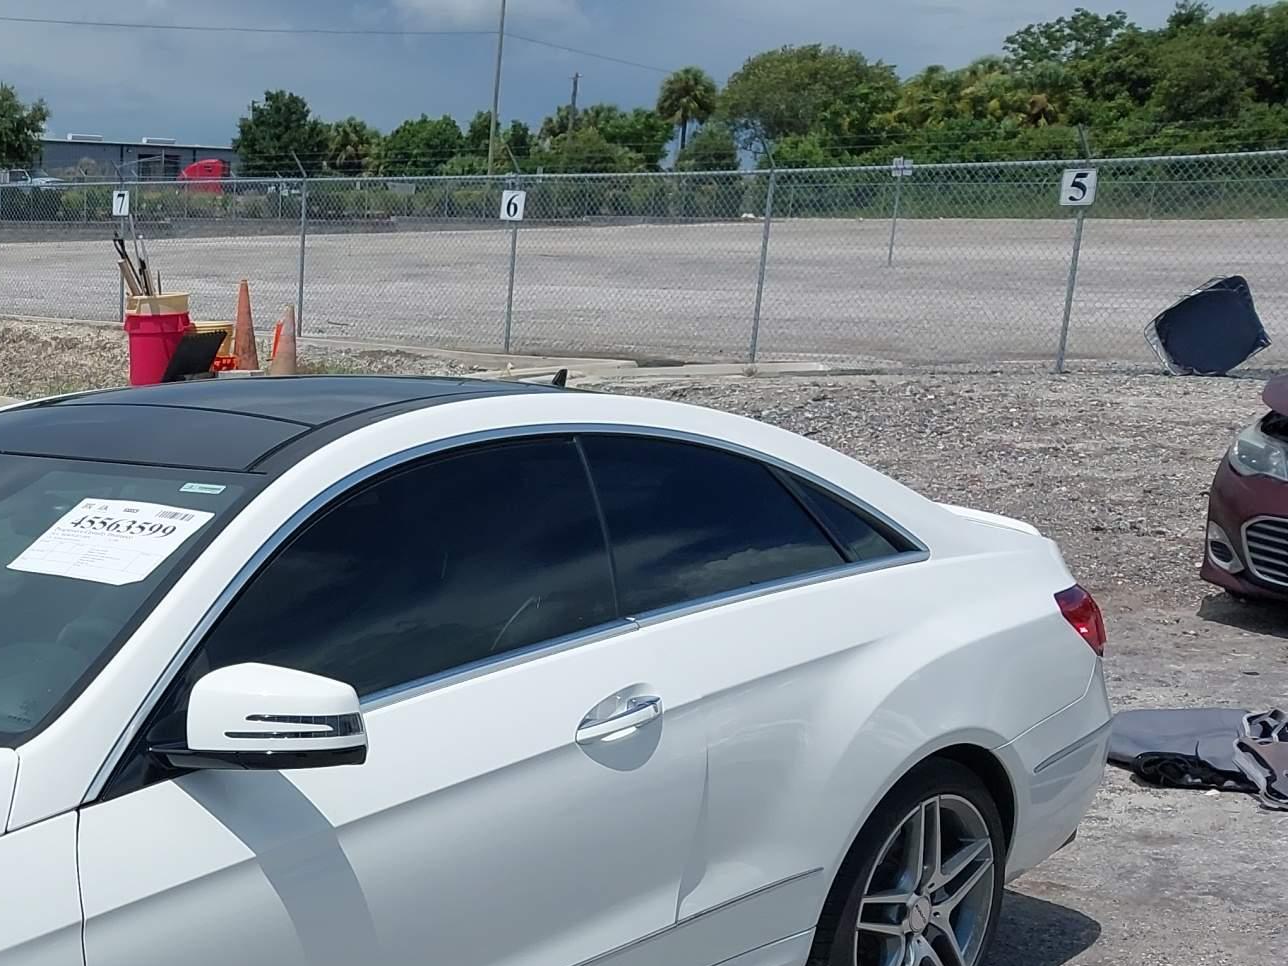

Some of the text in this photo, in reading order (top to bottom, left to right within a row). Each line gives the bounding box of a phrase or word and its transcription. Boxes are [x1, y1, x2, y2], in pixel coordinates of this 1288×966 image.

[1068, 172, 1089, 202] 5
[116, 193, 126, 214] 7
[506, 193, 519, 218] 6
[69, 514, 178, 539] 45563599
